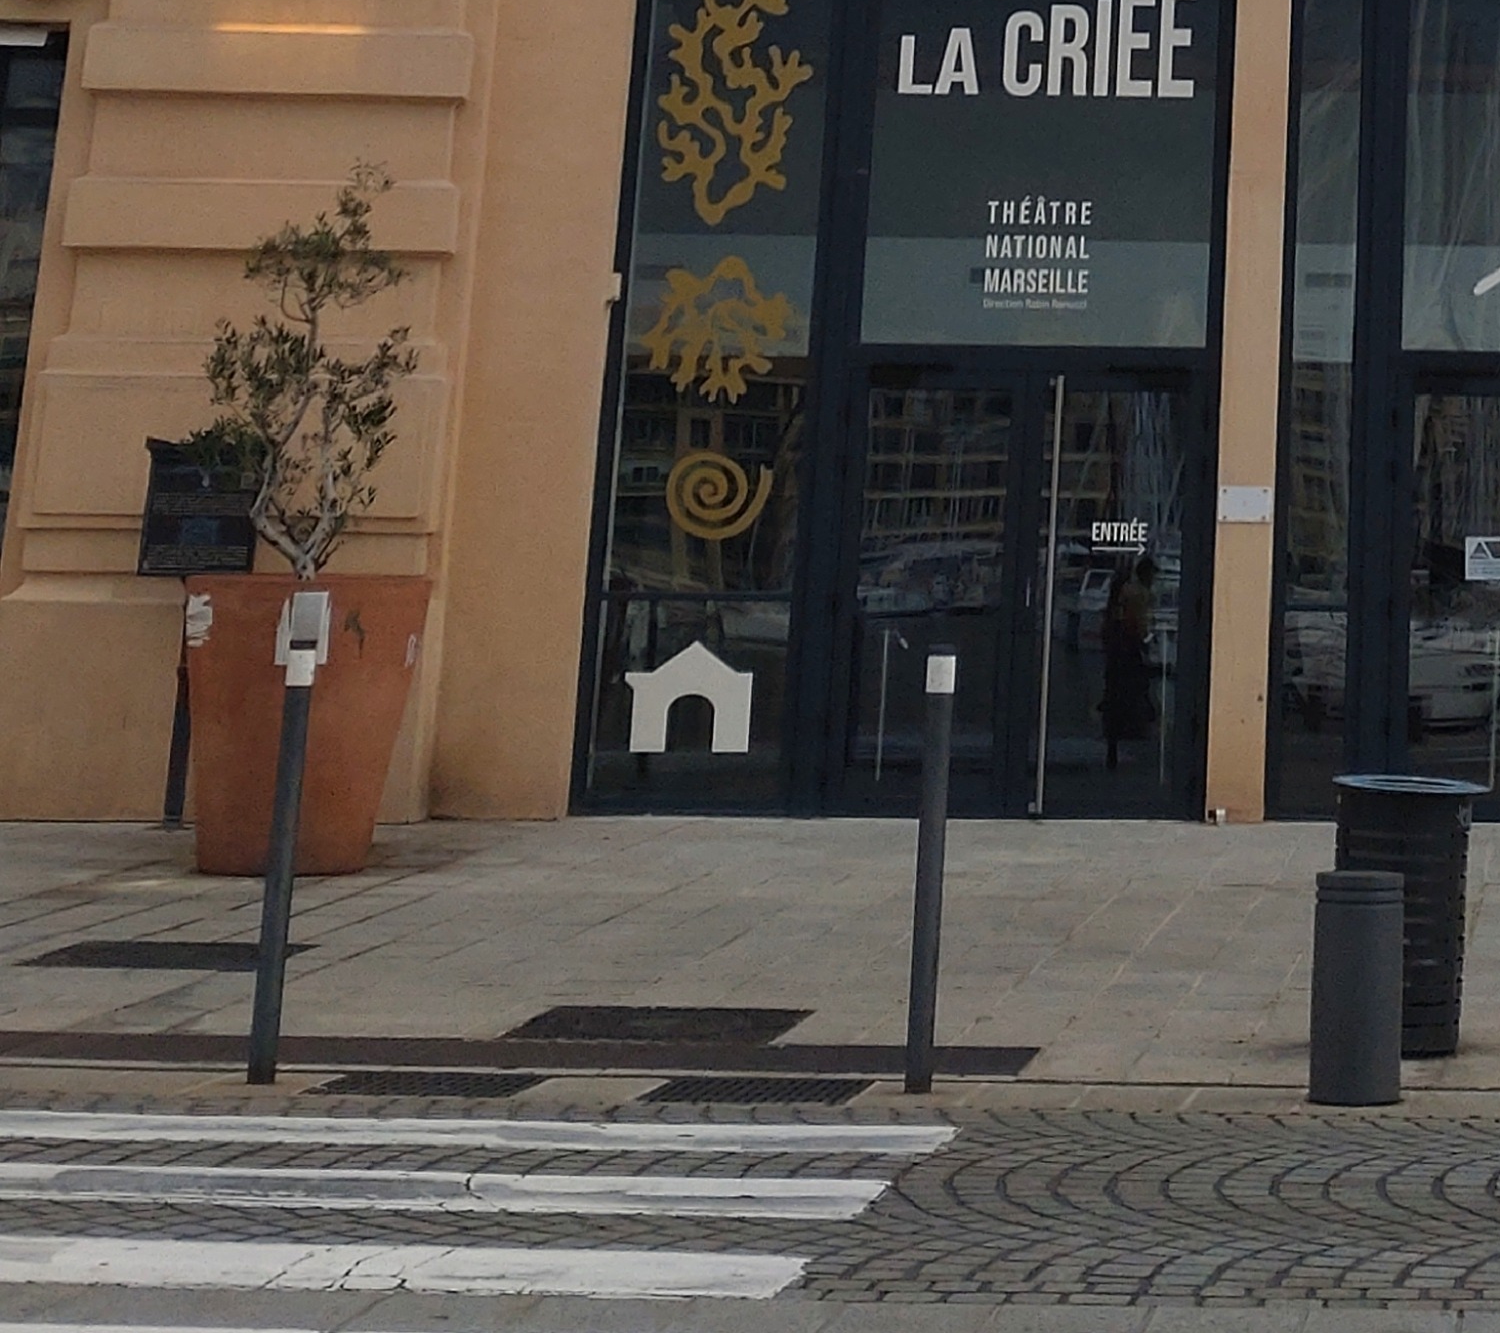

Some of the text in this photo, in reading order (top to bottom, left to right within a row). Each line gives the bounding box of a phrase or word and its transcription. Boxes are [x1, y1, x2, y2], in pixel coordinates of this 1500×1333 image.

[898, 27, 979, 95] LA
[987, 195, 1092, 225] THÉÂTRE
[985, 234, 1090, 259] NATIONAL
[984, 268, 1089, 293] MARSEILLE
[1091, 517, 1148, 542] ENTRÉE
